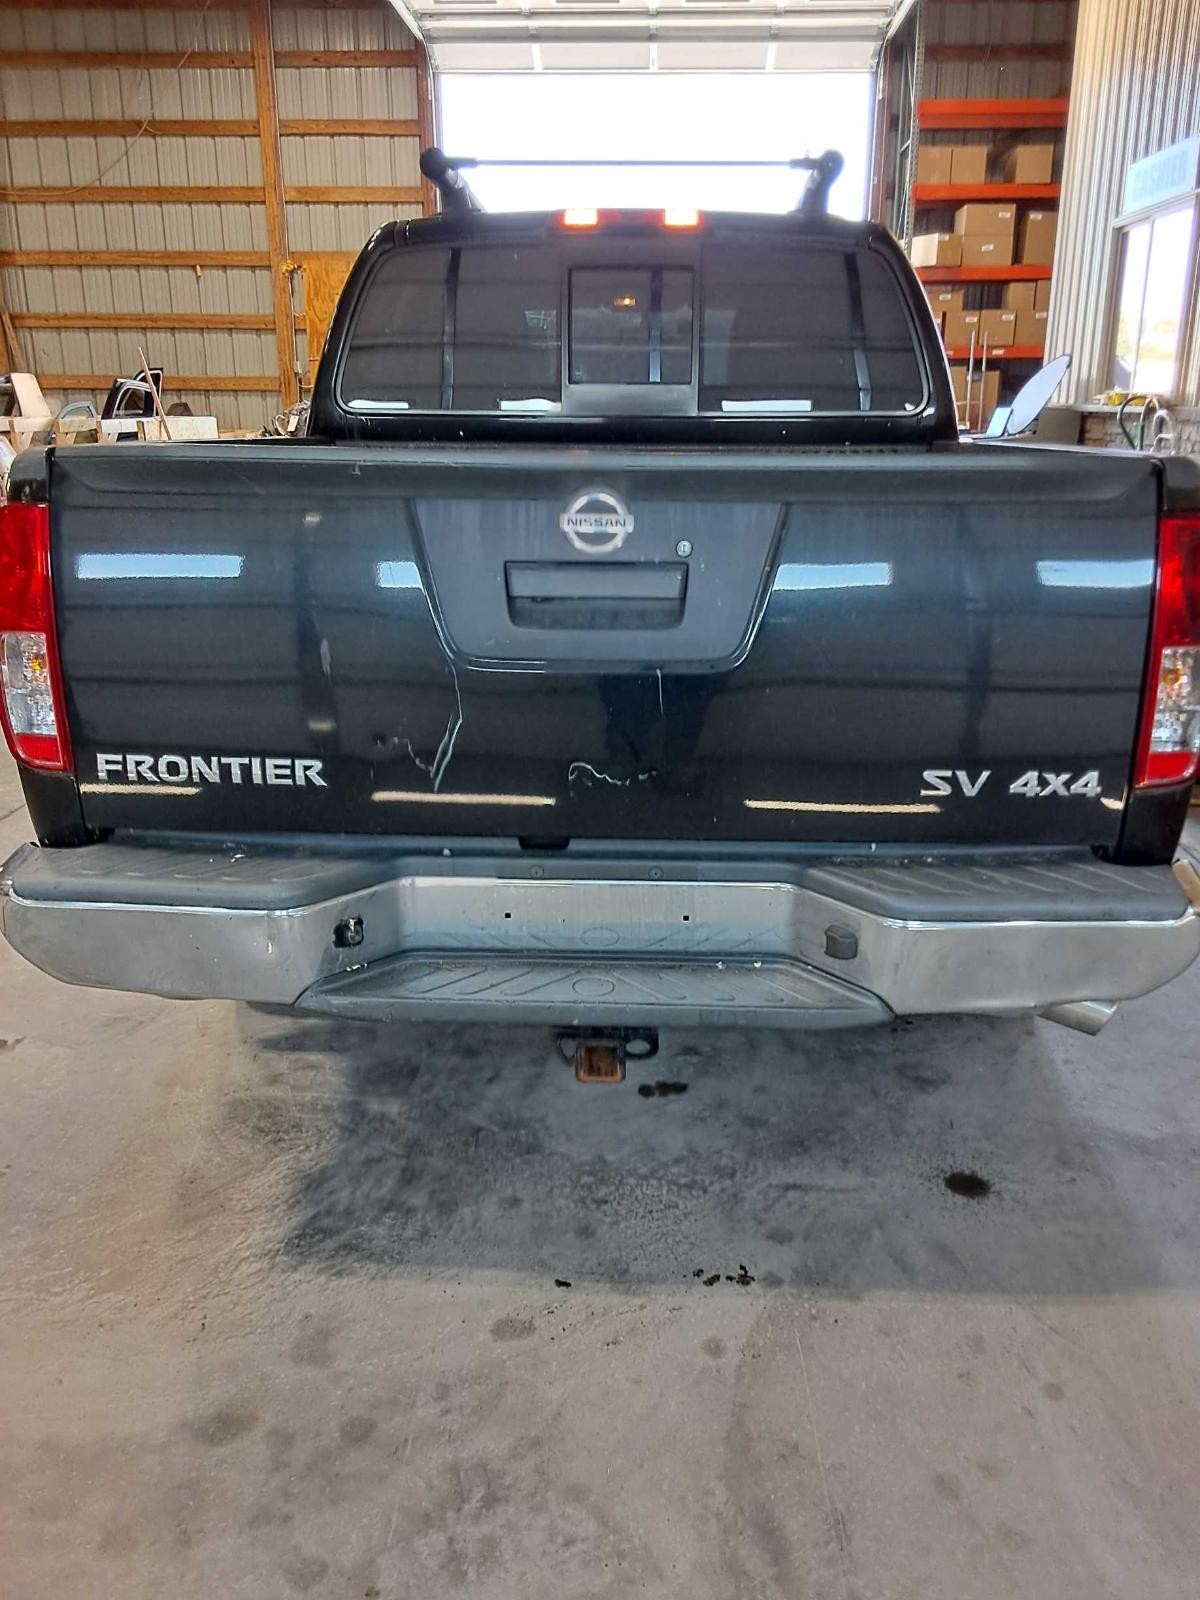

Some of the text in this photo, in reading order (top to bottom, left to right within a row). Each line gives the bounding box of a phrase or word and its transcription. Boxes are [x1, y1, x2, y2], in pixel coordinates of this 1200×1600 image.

[566, 517, 627, 528] NISSAN
[96, 753, 328, 787] FRONTIER
[919, 769, 992, 797] SV
